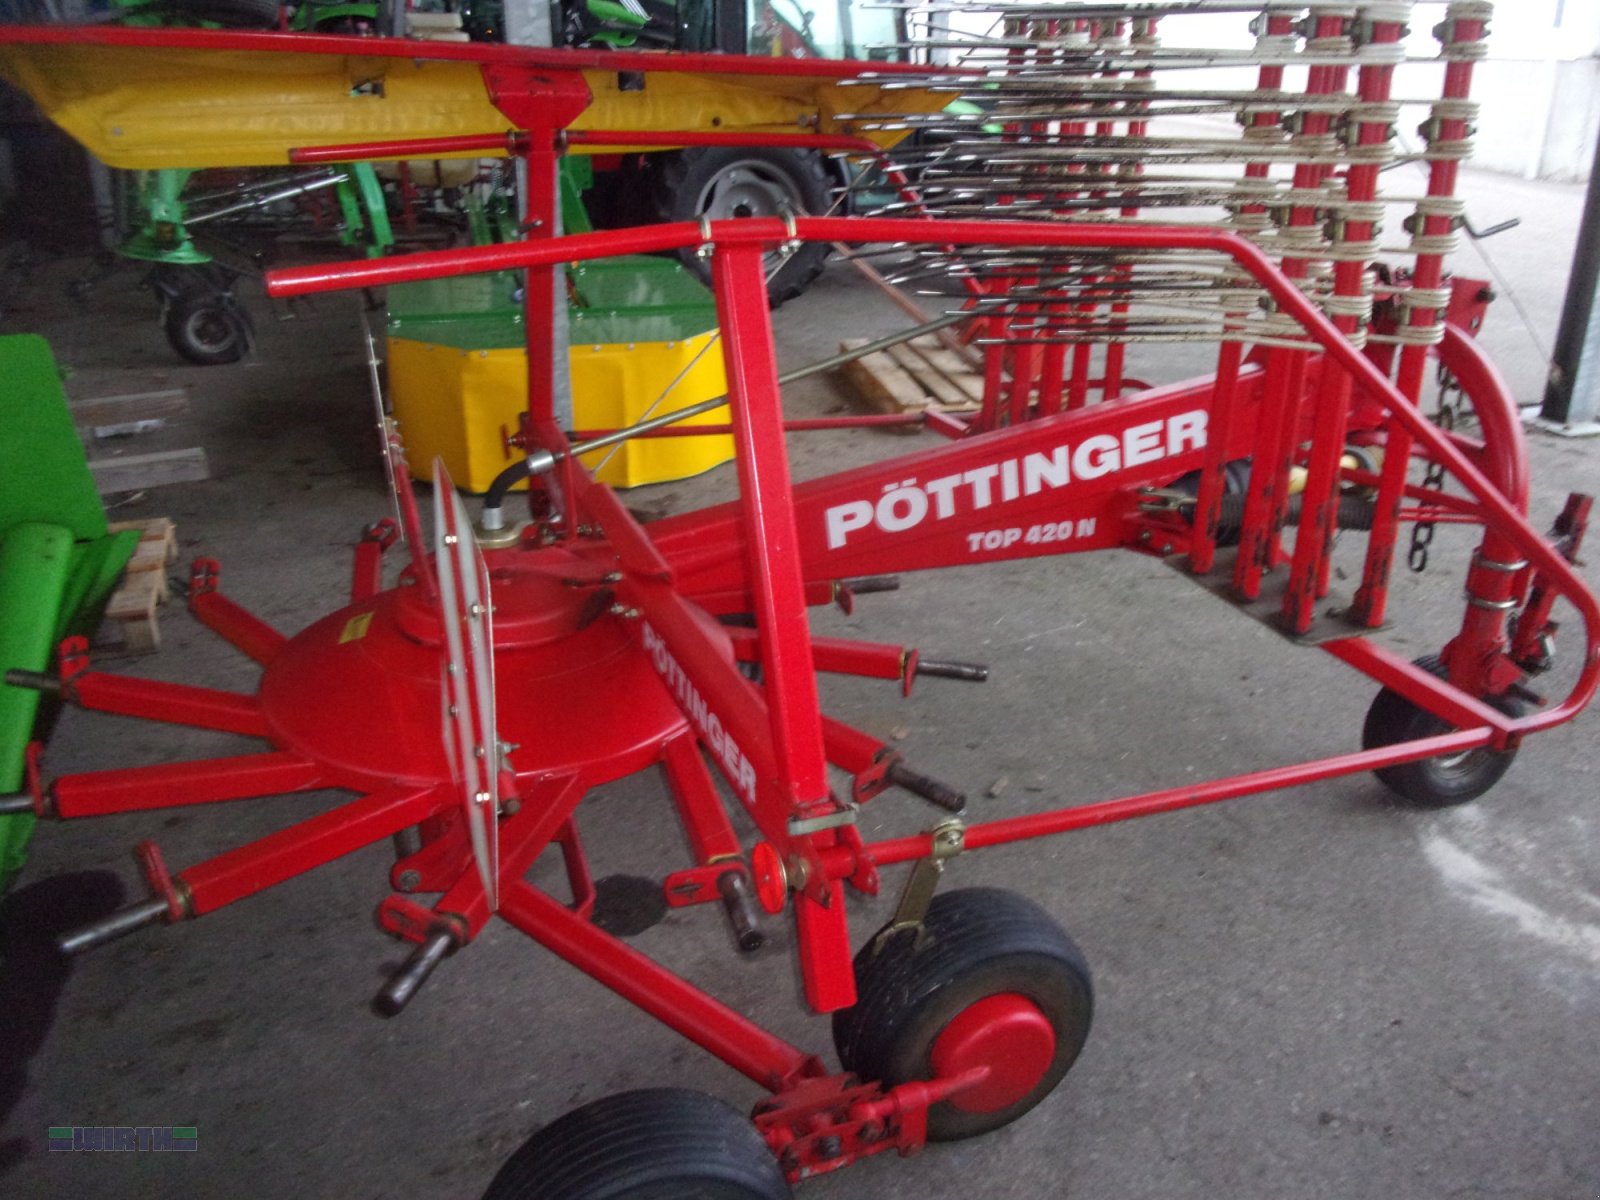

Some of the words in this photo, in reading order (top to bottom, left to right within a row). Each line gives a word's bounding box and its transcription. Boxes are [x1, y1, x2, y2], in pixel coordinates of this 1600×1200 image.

[826, 409, 1208, 550] PÖTTINGER
[967, 527, 1022, 552] TOP
[1024, 520, 1073, 545] 420
[1076, 517, 1096, 537] N
[643, 621, 756, 804] PÖTTINGER
